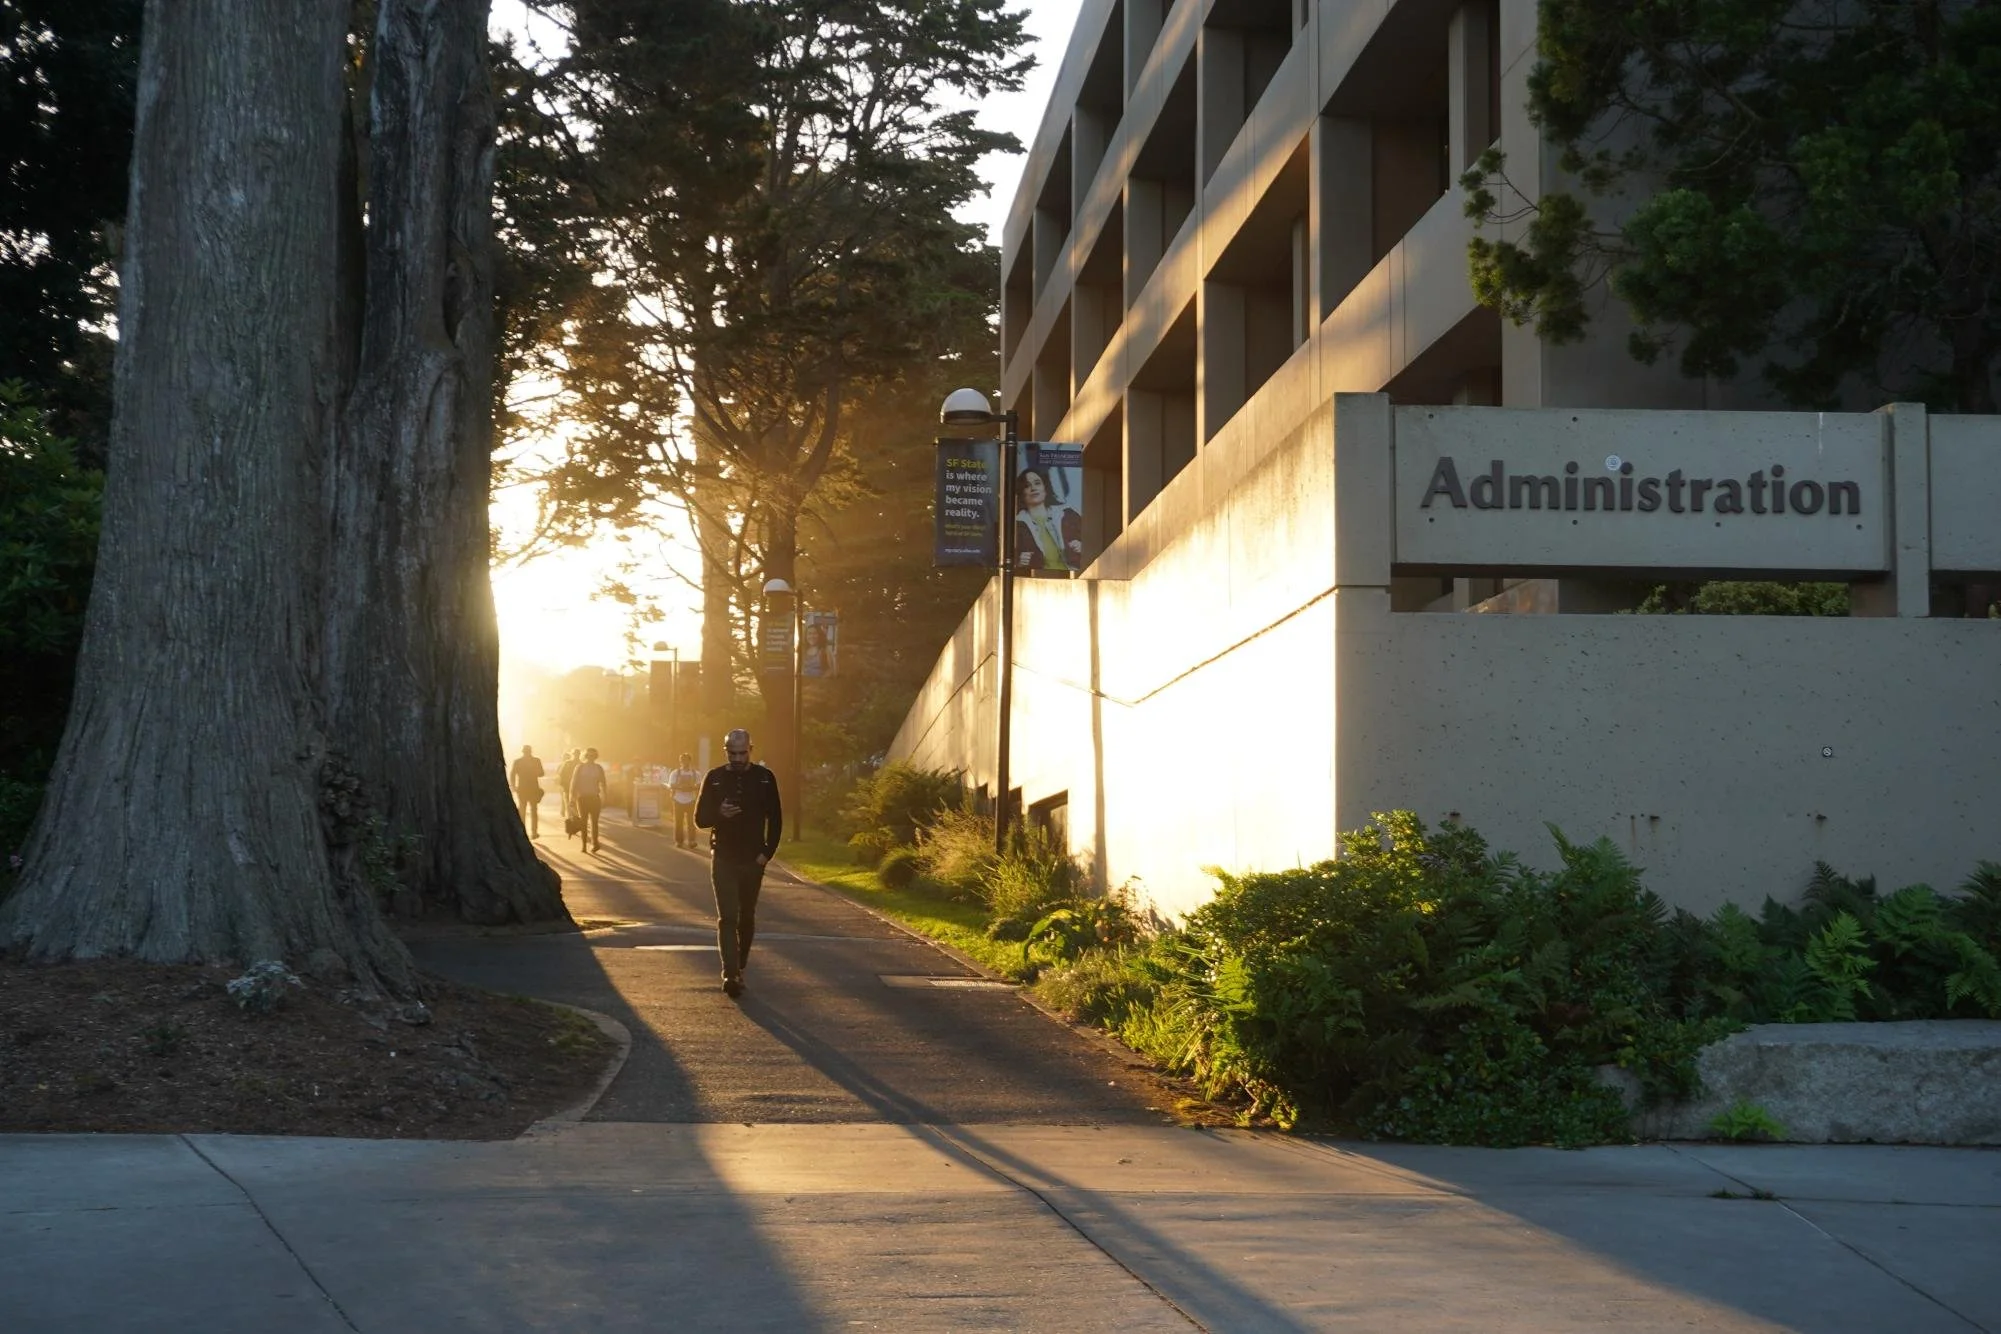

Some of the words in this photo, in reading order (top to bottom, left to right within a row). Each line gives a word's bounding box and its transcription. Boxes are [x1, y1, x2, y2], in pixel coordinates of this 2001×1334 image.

[945, 458, 959, 468] SF
[960, 459, 986, 469] State
[945, 470, 955, 480] is
[956, 471, 988, 481] where
[945, 484, 961, 495] my
[962, 484, 992, 494] vision
[1420, 456, 1862, 516] Administration
[945, 495, 984, 505] became
[944, 508, 980, 519] reality.
